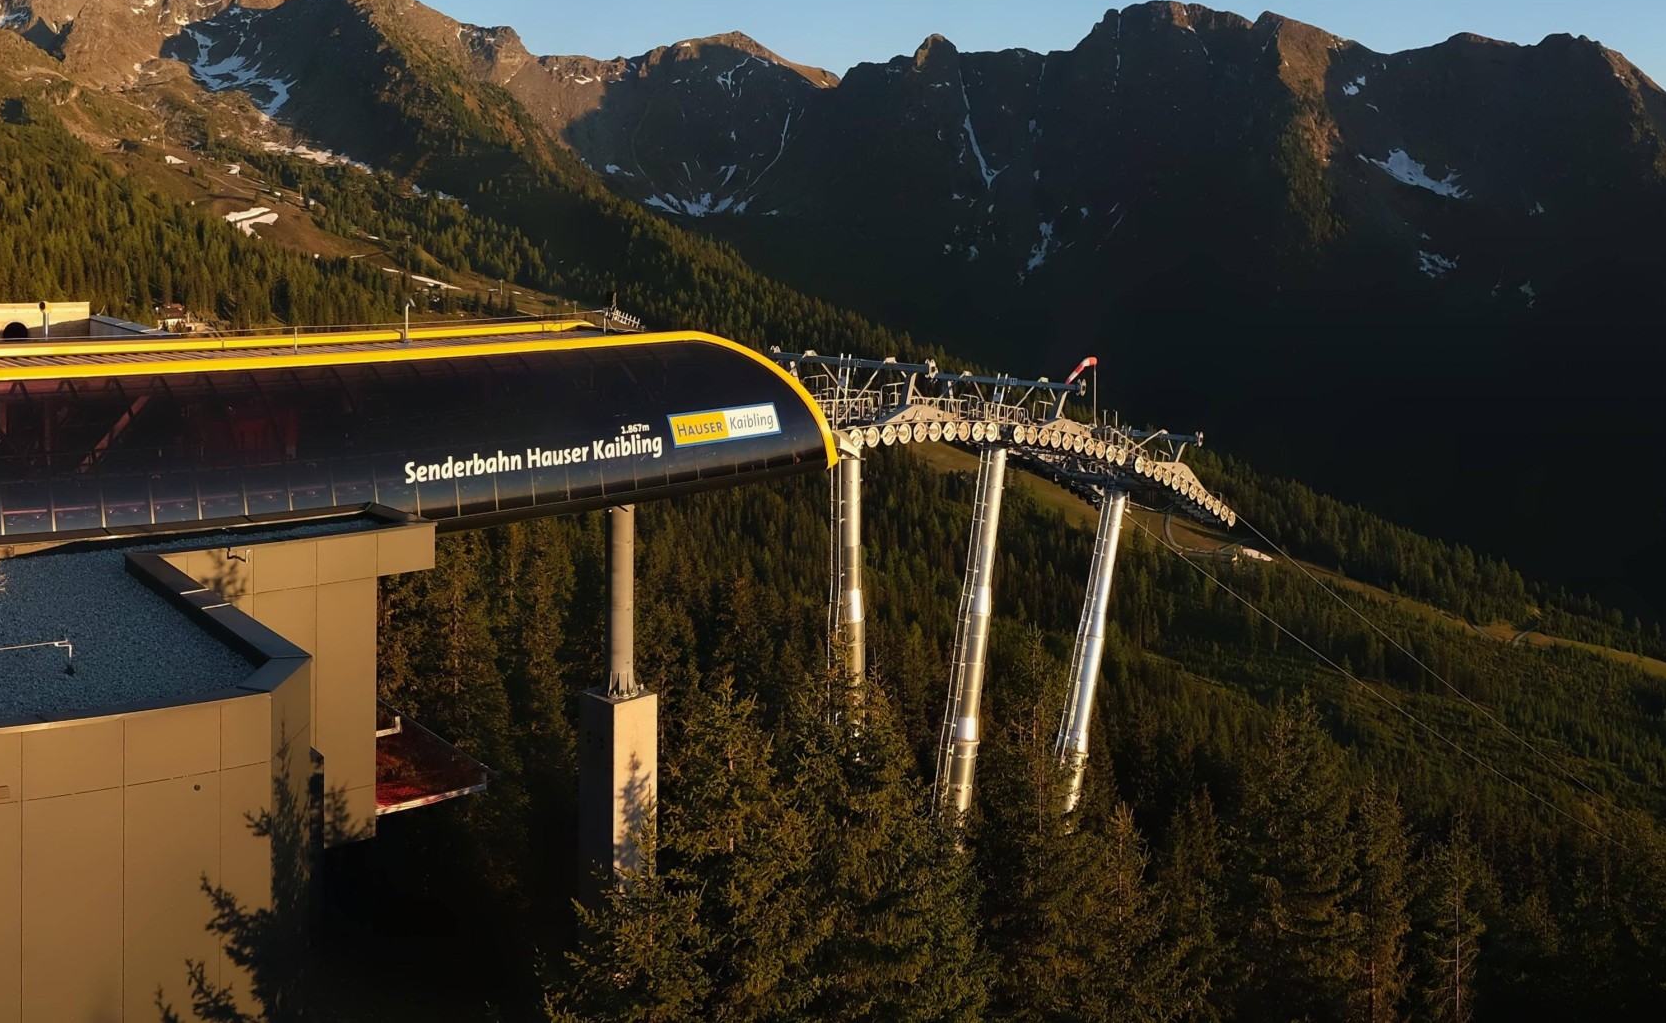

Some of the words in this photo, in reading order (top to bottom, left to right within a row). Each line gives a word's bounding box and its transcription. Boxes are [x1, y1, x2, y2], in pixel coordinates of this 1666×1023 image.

[621, 423, 650, 434] 1.867m
[677, 421, 724, 437] HAUSER
[729, 407, 774, 430] Kaibling
[404, 450, 522, 484] Senderbahn
[527, 444, 589, 469] Hauser
[593, 434, 663, 459] Kaibling
